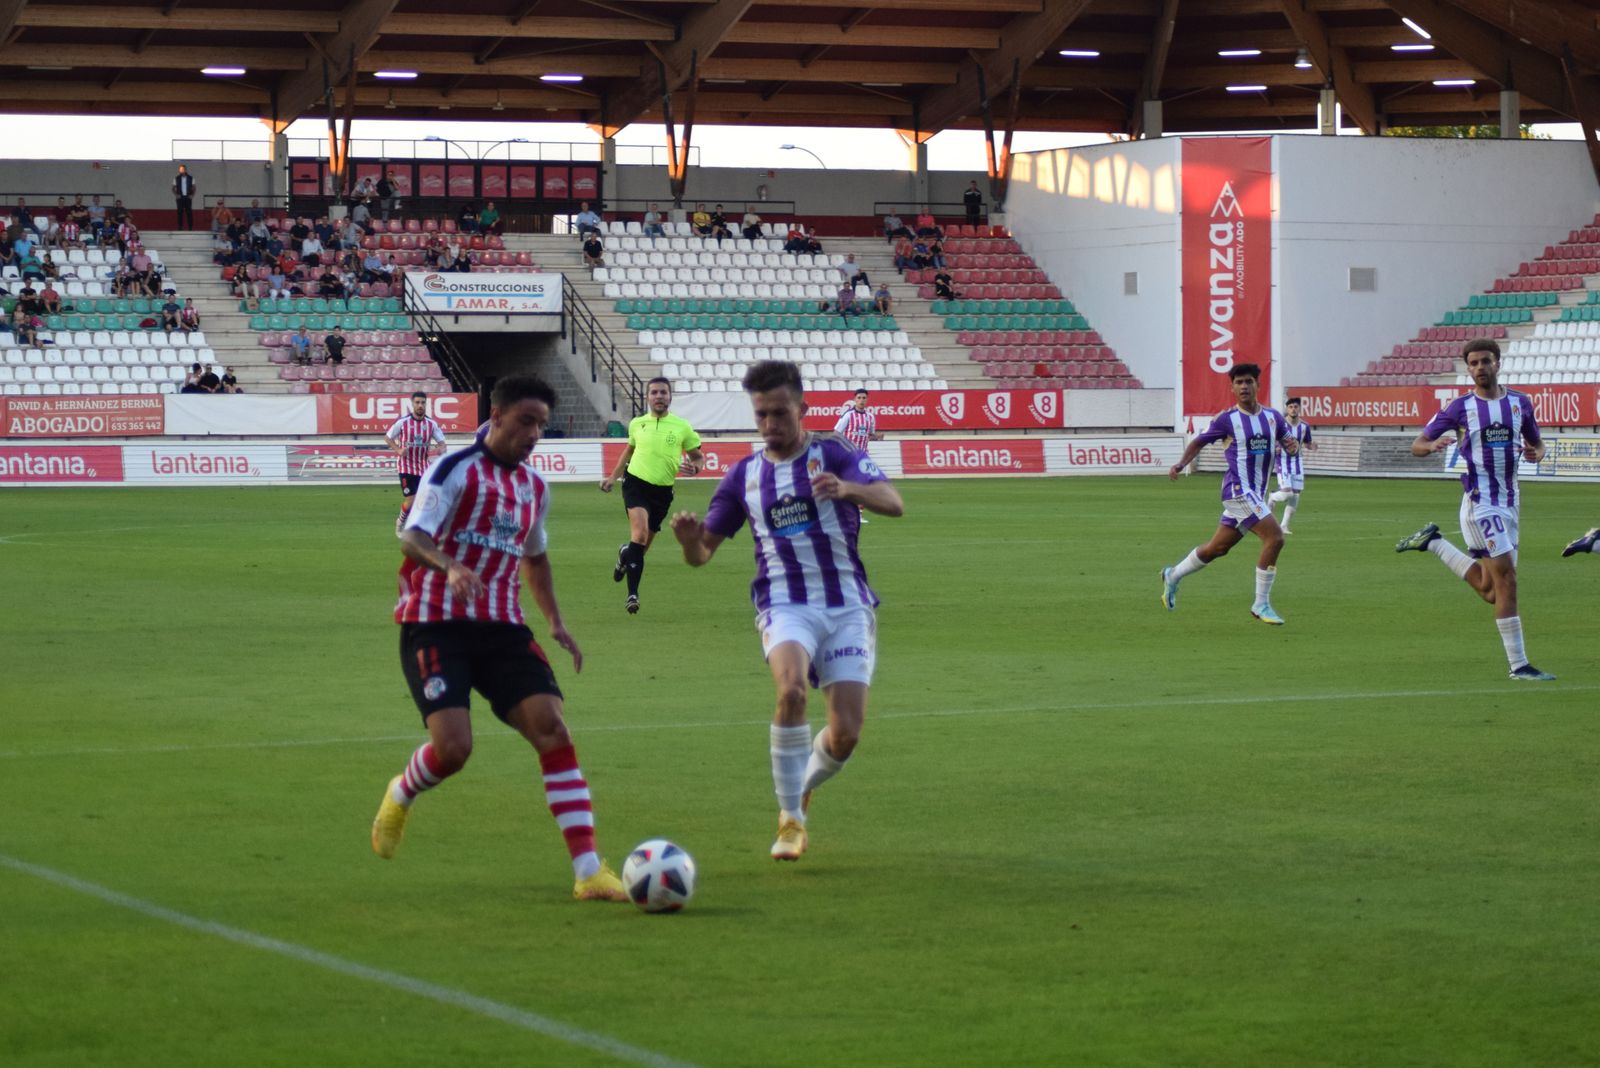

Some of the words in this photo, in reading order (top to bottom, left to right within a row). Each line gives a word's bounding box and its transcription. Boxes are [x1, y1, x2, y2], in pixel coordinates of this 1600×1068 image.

[1236, 221, 1244, 242] ADO
[424, 274, 544, 292] CONSTRUCCIONES
[1209, 221, 1234, 374] avanza
[8, 401, 41, 411] DAVID
[42, 401, 53, 410] A.
[55, 398, 119, 410] HERNÁNDEZ
[121, 399, 162, 409] BERNAL
[949, 396, 959, 414] 8
[995, 396, 1006, 414] 8
[1042, 395, 1051, 413] 8
[1300, 396, 1332, 417] RIAS
[1335, 402, 1419, 417] AUTOESCUELA
[9, 416, 104, 433] ABOGADO
[111, 422, 127, 431] 635
[128, 422, 144, 431] 365
[145, 421, 161, 430] 442
[152, 450, 249, 474] lantania
[925, 444, 1011, 468] lantania
[1068, 443, 1152, 465] lantania
[770, 502, 808, 519] Estrella
[774, 513, 808, 528] Galicia
[1480, 515, 1505, 539] 20
